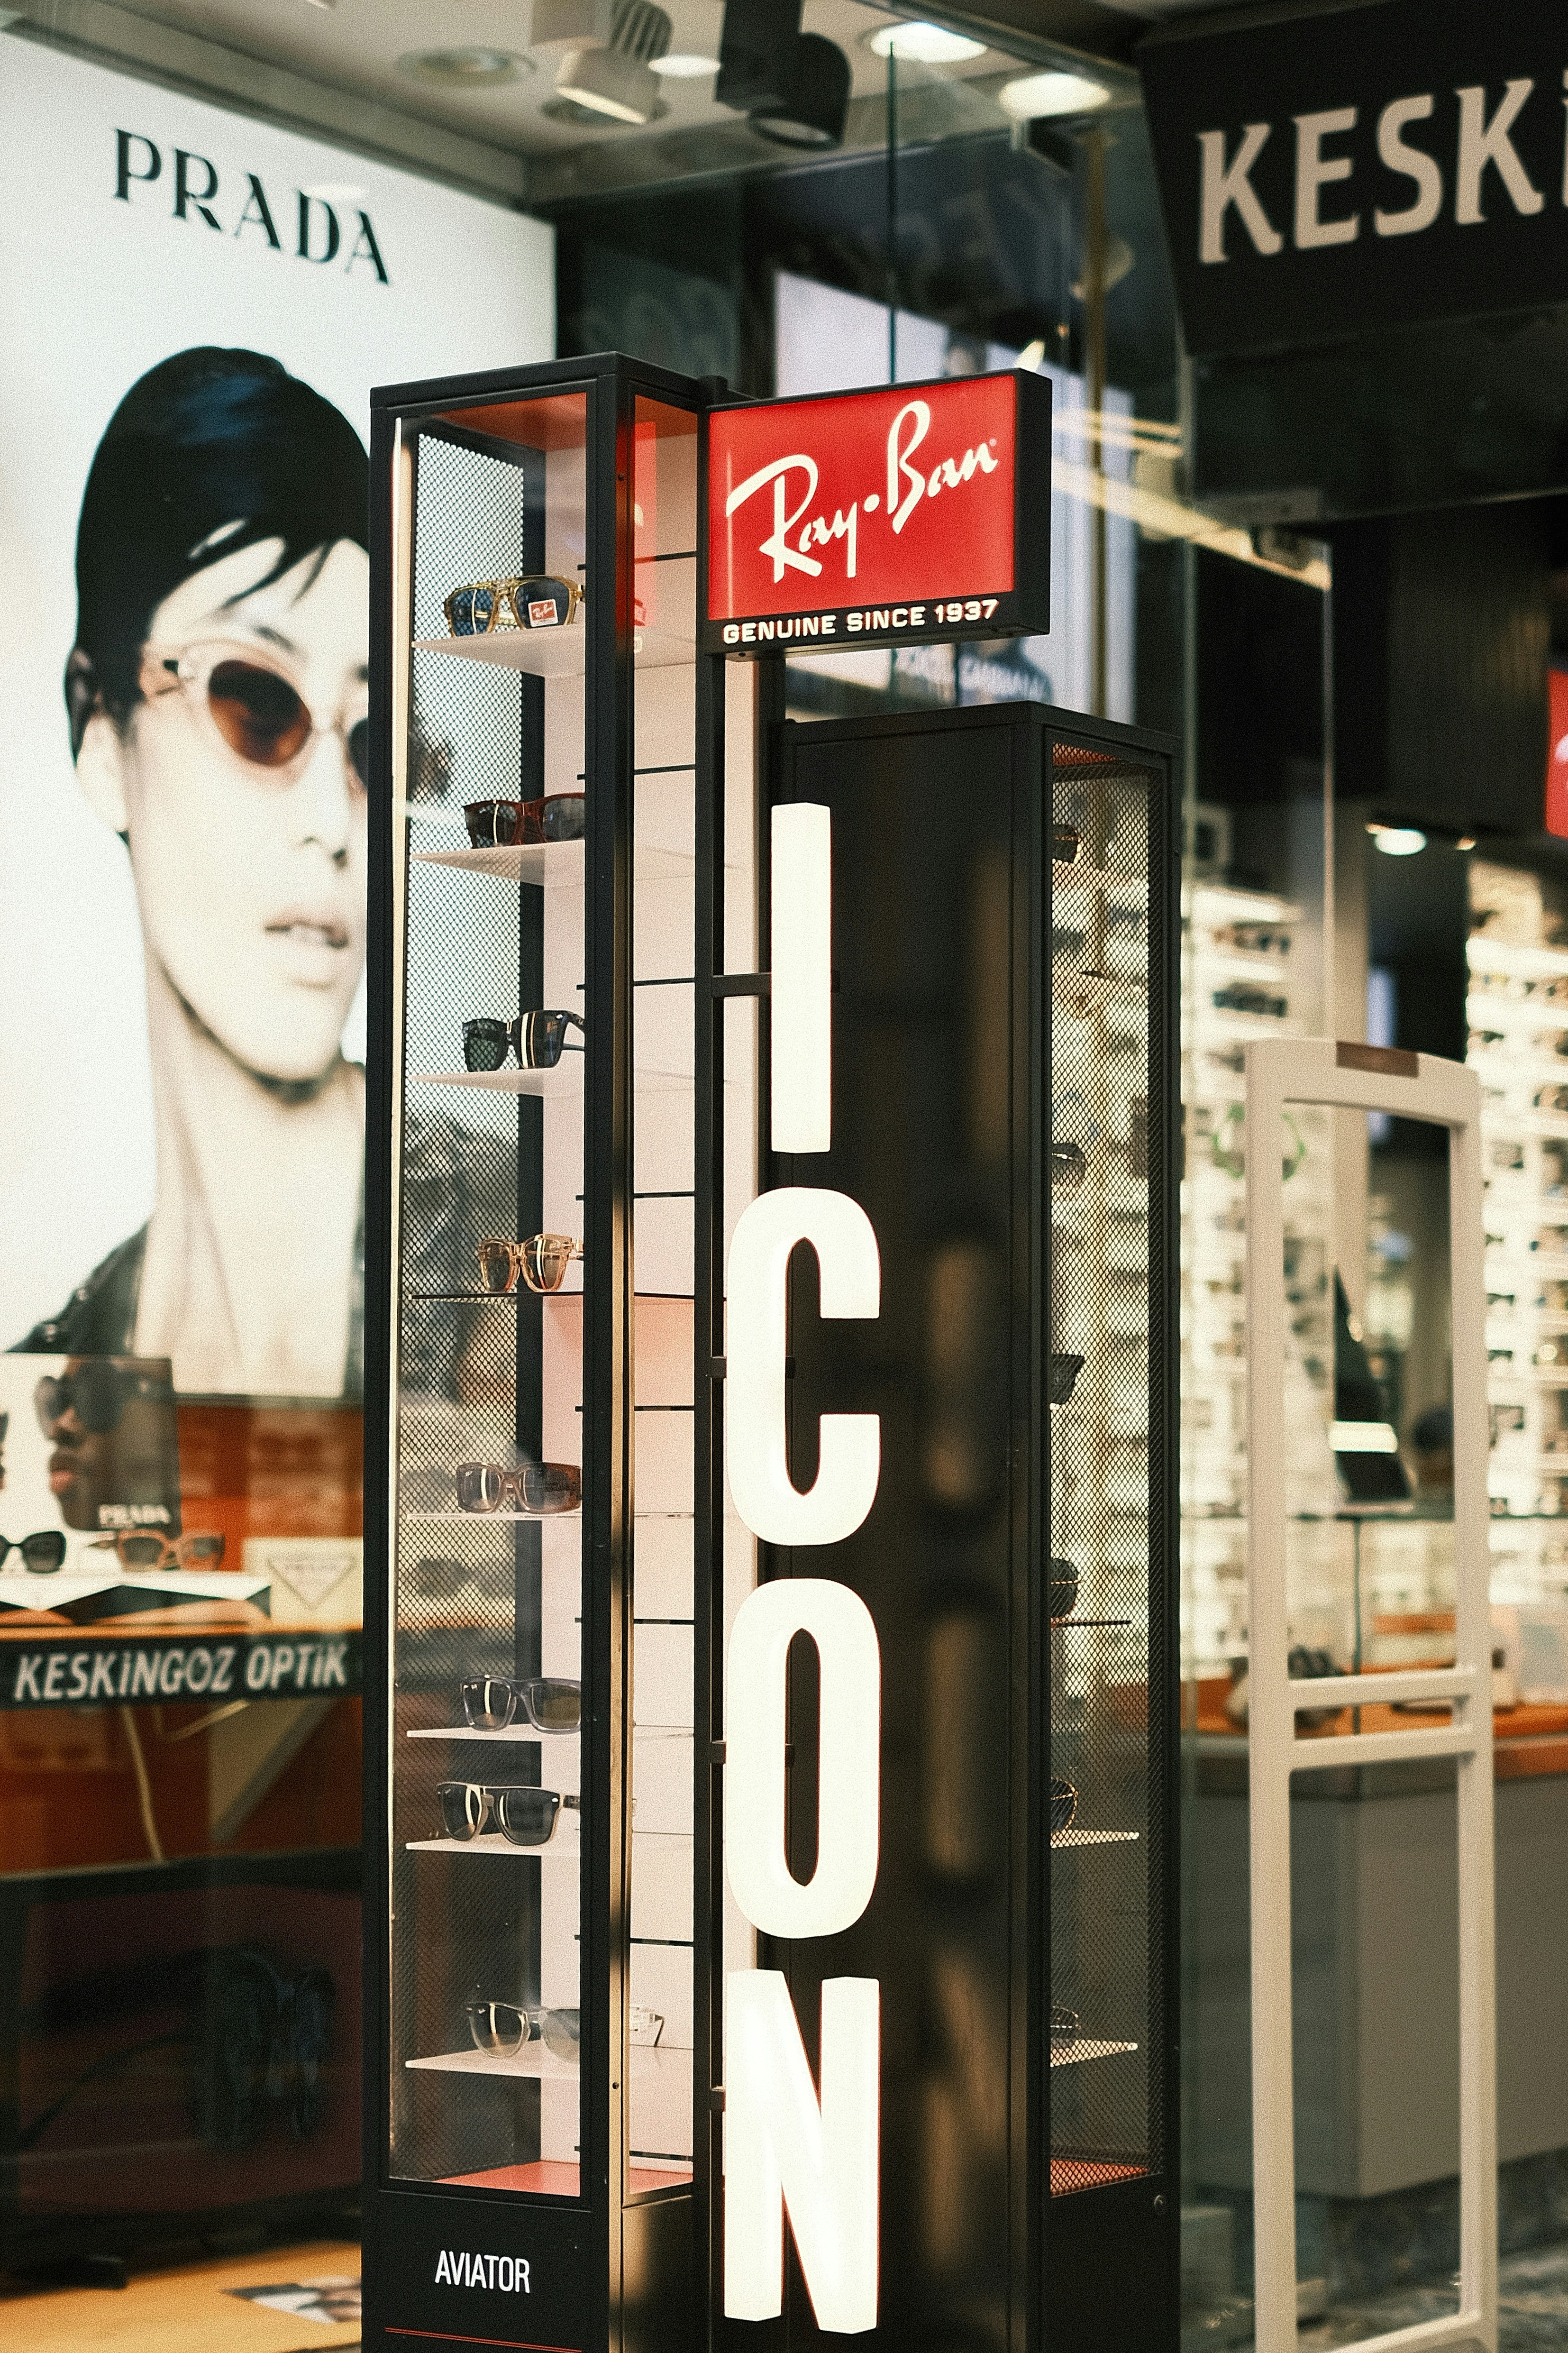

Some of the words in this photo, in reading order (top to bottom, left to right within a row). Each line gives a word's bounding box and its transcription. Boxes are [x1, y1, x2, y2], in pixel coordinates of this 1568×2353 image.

[114, 128, 390, 286] PRADA
[1196, 69, 1568, 265] KESK
[722, 615, 837, 645] GENUINE
[846, 605, 926, 632] SINCE
[933, 599, 999, 624] 1937
[724, 802, 880, 2334] ICON
[435, 2250, 530, 2294] AVIATOR
